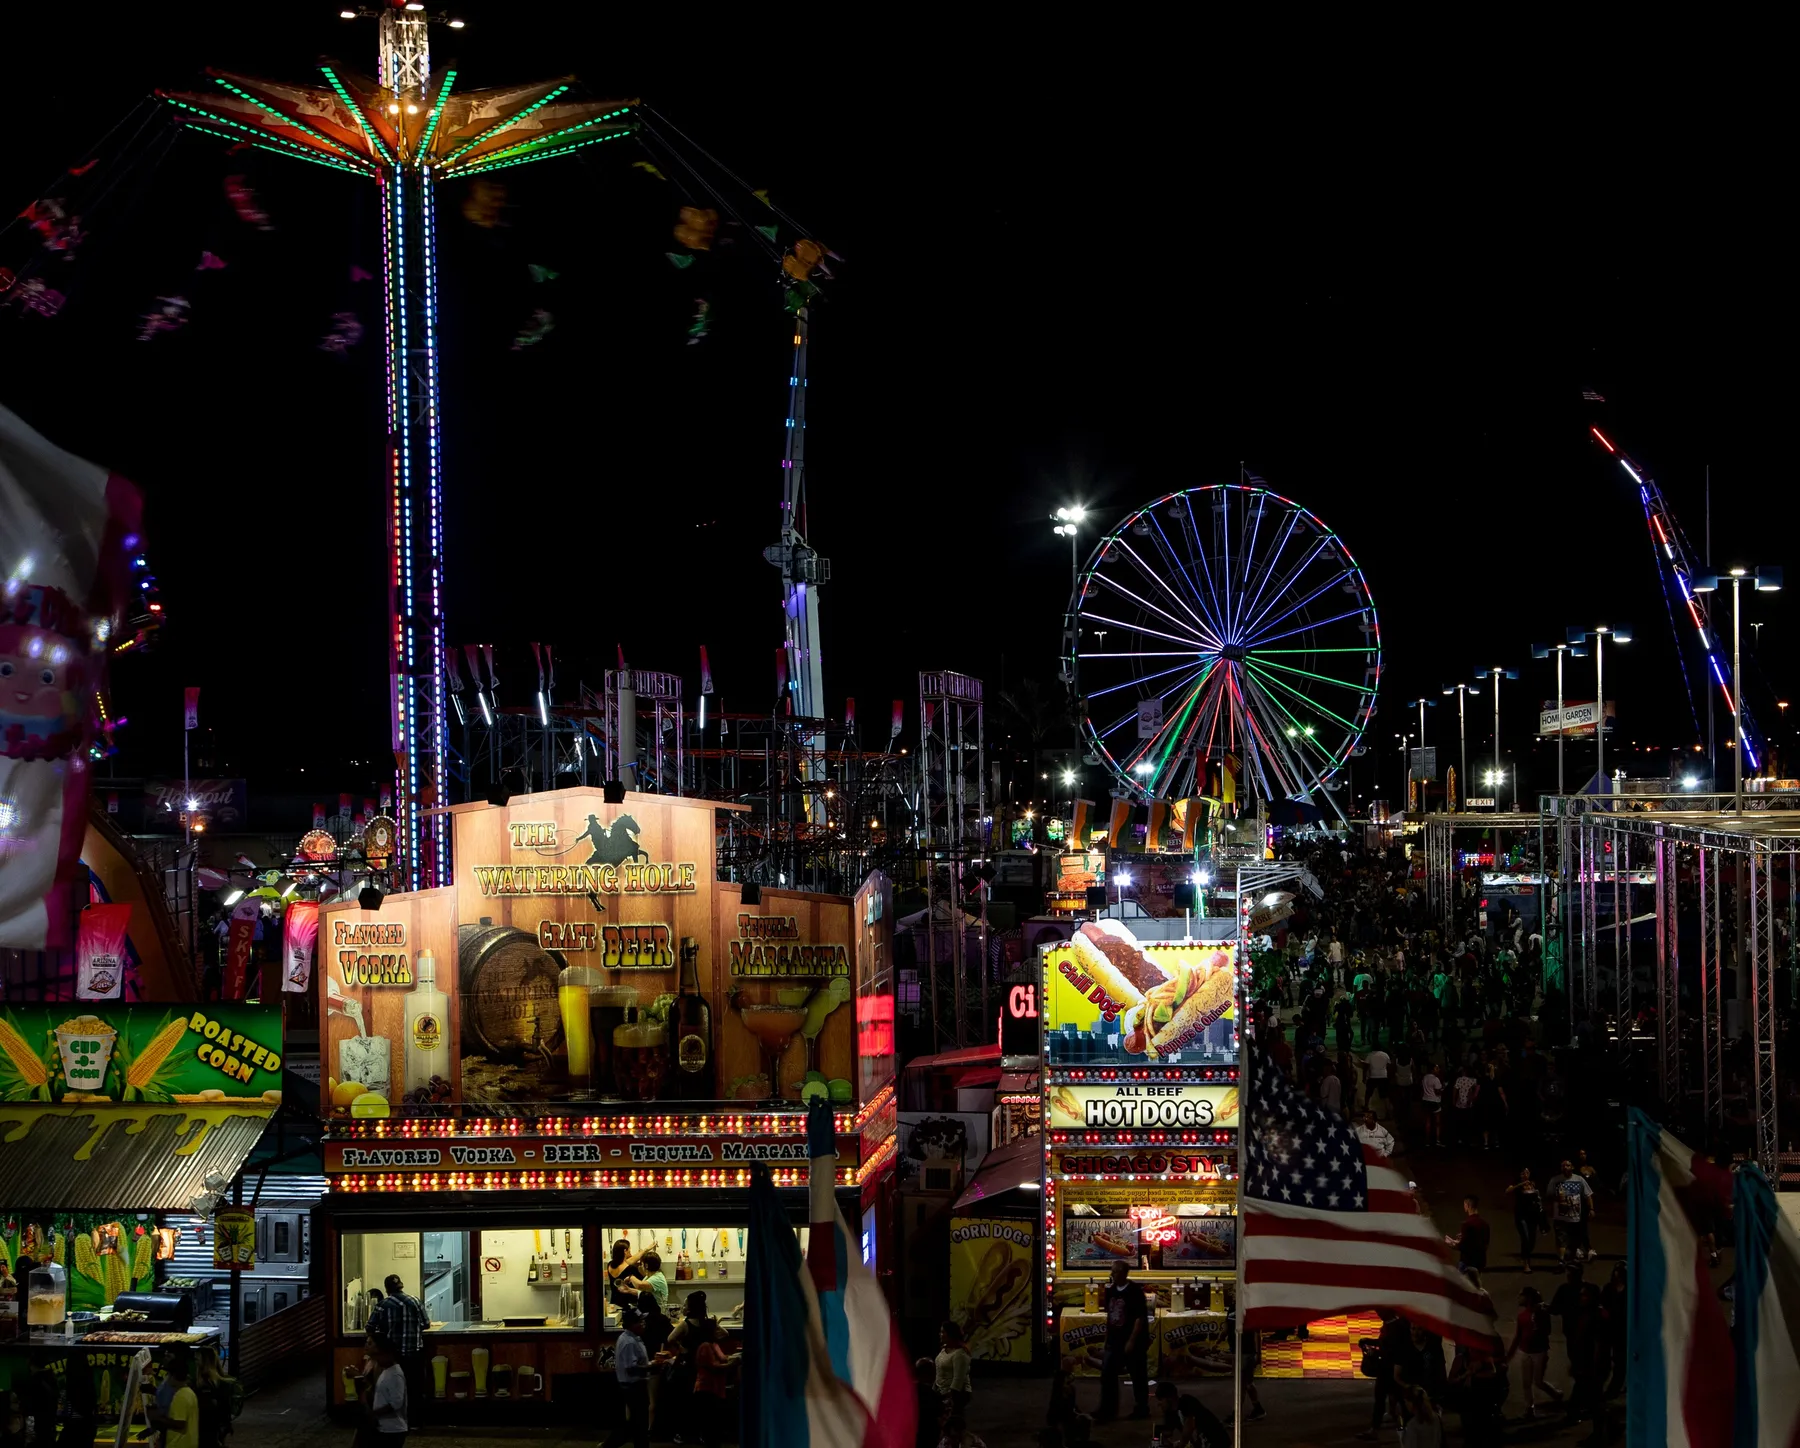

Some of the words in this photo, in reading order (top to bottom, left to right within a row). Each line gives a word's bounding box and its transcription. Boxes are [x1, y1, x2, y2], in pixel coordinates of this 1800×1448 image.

[1565, 707, 1592, 721] GARDEN
[1578, 716, 1593, 724] SHOW
[155, 786, 235, 806] Haout
[1475, 798, 1494, 806] EXIT
[510, 822, 557, 847] THE
[474, 864, 619, 895] WATERING
[624, 863, 695, 893] HOLE
[335, 921, 405, 945] FLAVORED
[738, 913, 799, 940] TEQUILA
[539, 920, 597, 950] CRAFT
[602, 924, 673, 968] BEER
[339, 950, 412, 985] VODKA
[730, 941, 850, 976] MARGARITA
[488, 971, 508, 983] THE
[481, 985, 558, 1005] WATERING
[1009, 984, 1039, 1018] Ci
[1058, 960, 1096, 995] Chili
[1087, 984, 1127, 1023] Dog
[501, 1003, 541, 1021] HOLE
[1154, 1029, 1197, 1058] Peppers
[1192, 1021, 1206, 1033] &
[1200, 1000, 1232, 1026] Onions
[70, 1040, 101, 1054] CUP
[189, 1012, 282, 1072] ROASTED
[197, 1043, 255, 1084] CORN
[69, 1068, 100, 1080] CORN
[1115, 1087, 1143, 1097] ALL
[1147, 1087, 1184, 1097] BEEF
[1085, 1100, 1138, 1127] HOT
[1140, 1100, 1214, 1127] DOGS
[343, 1148, 441, 1166] FLAVORED
[450, 1146, 515, 1165] VODKA
[543, 1145, 601, 1163] BEER
[630, 1143, 713, 1163] TEQUILA
[1060, 1155, 1168, 1174] CHICAGO
[1130, 1208, 1164, 1220] CORN
[1104, 1219, 1119, 1231] HOT
[1201, 1219, 1215, 1231] HOT
[952, 1223, 990, 1243] CORN
[992, 1223, 1032, 1248] DOGS
[1146, 1229, 1178, 1242] DOGS
[1062, 1322, 1108, 1342] CHICAG
[1164, 1321, 1218, 1343] CHICAGO
[86, 1353, 117, 1367] ORN
